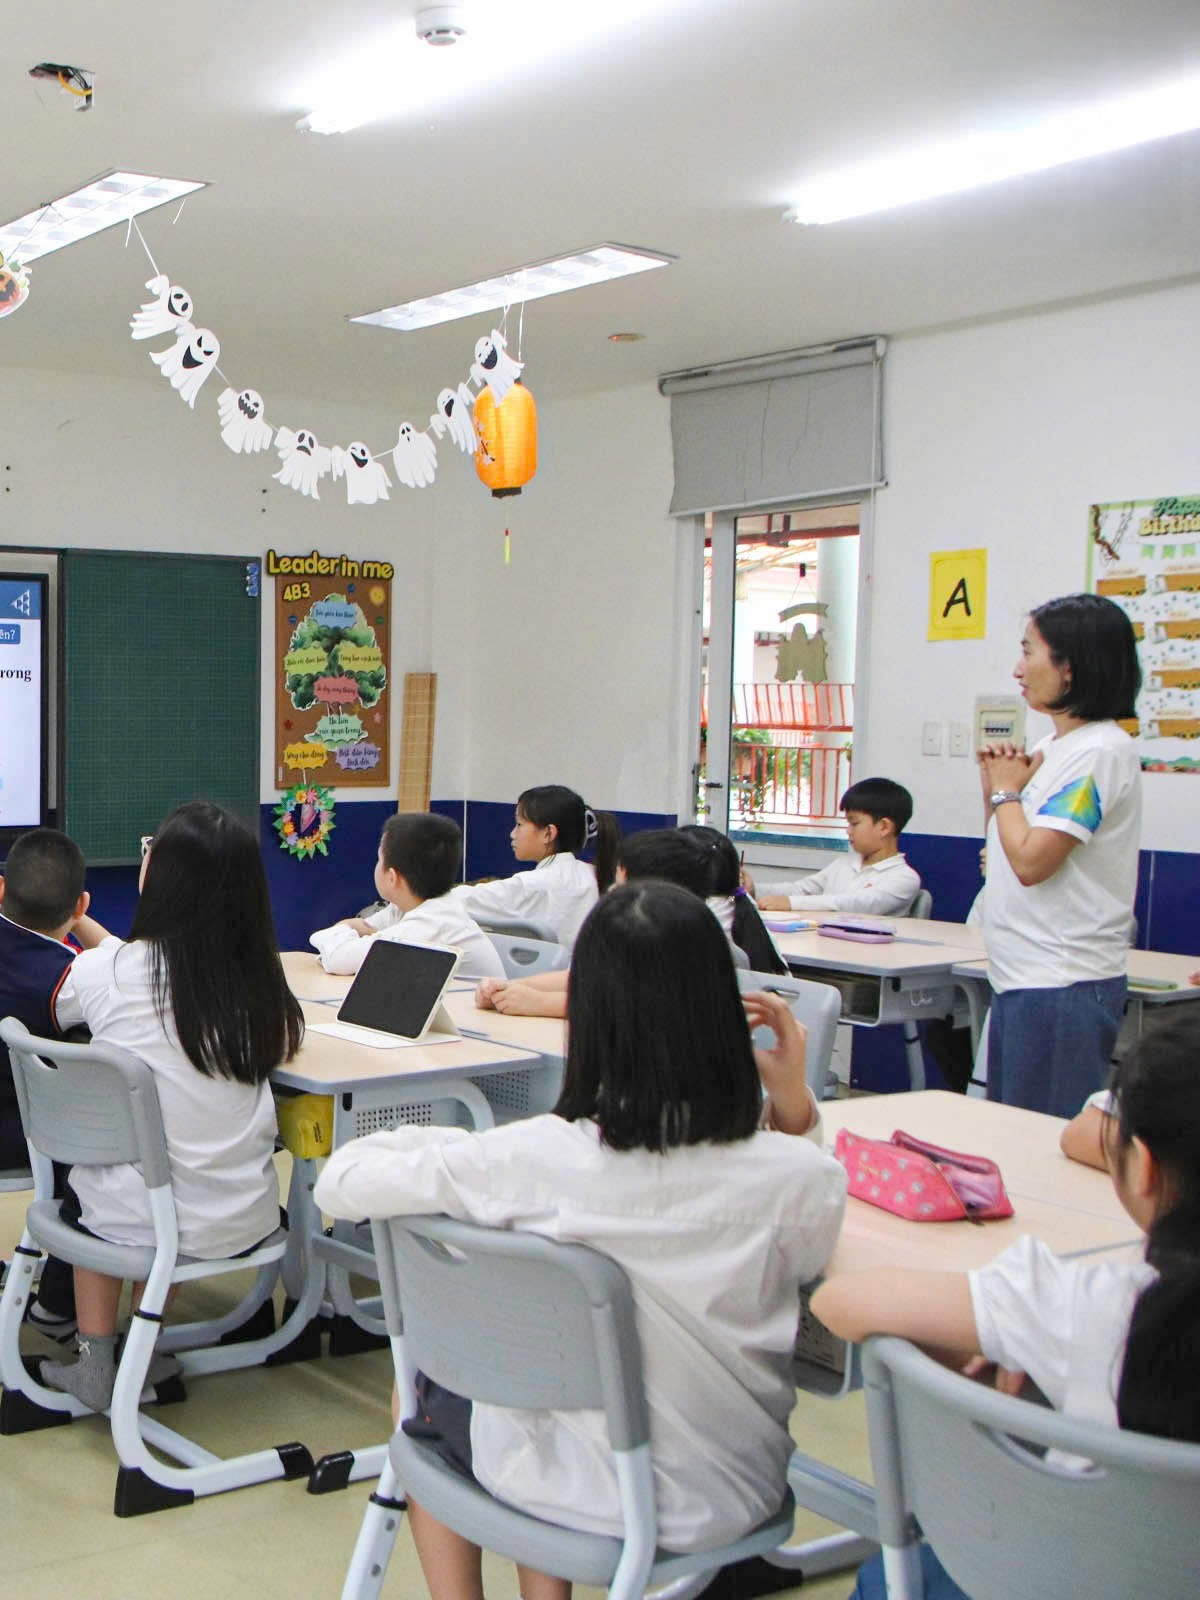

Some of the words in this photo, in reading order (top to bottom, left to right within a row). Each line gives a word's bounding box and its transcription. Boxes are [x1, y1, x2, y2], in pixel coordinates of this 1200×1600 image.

[268, 550, 340, 576] Leader
[341, 554, 359, 577] in
[362, 561, 394, 579] me
[282, 582, 311, 601] 4B3
[942, 577, 971, 618] A
